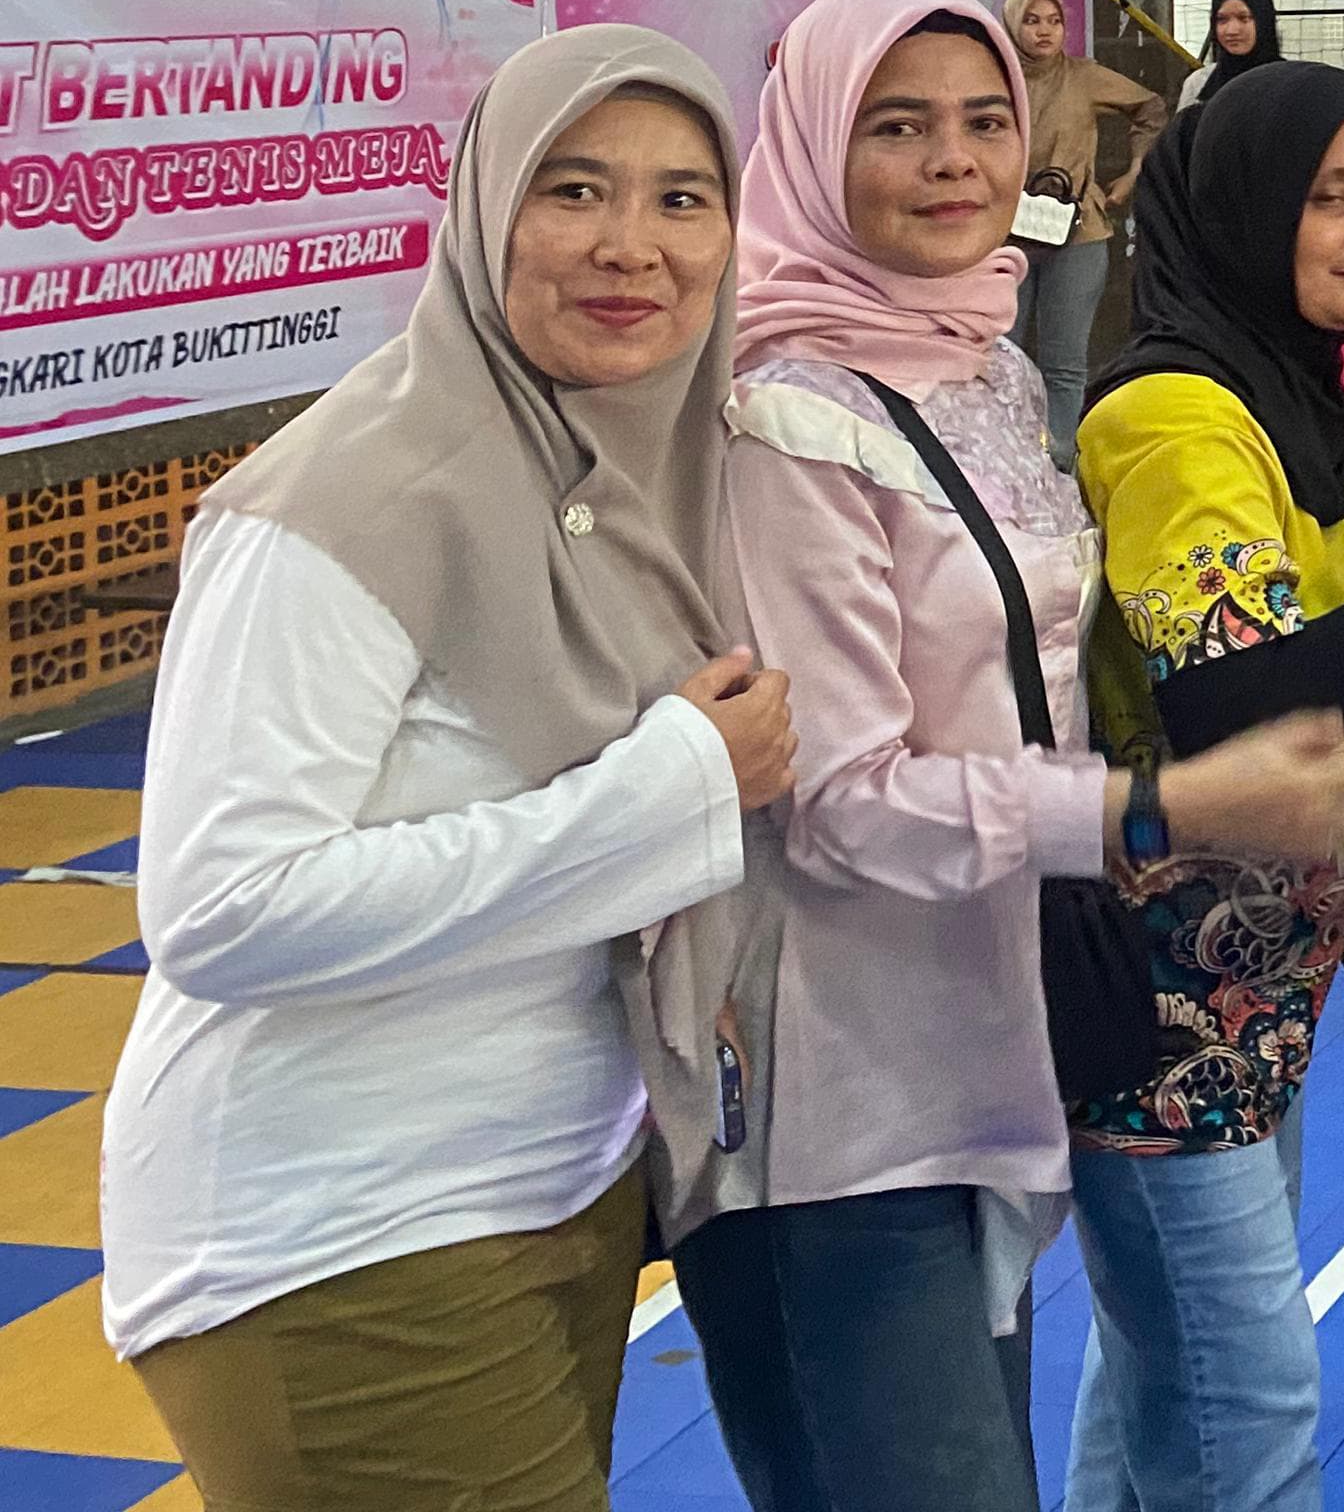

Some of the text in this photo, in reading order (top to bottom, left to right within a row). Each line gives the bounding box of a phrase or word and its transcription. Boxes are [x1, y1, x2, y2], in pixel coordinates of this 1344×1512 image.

[44, 30, 407, 129] BERTANDING
[11, 128, 449, 230] DAN TENIS MEJA
[75, 249, 216, 306] LAKUKAN
[222, 242, 290, 285] YANG
[297, 225, 408, 274] TERBAIK
[92, 335, 164, 381] KOTA
[172, 306, 342, 368] BUKITTINGGI
